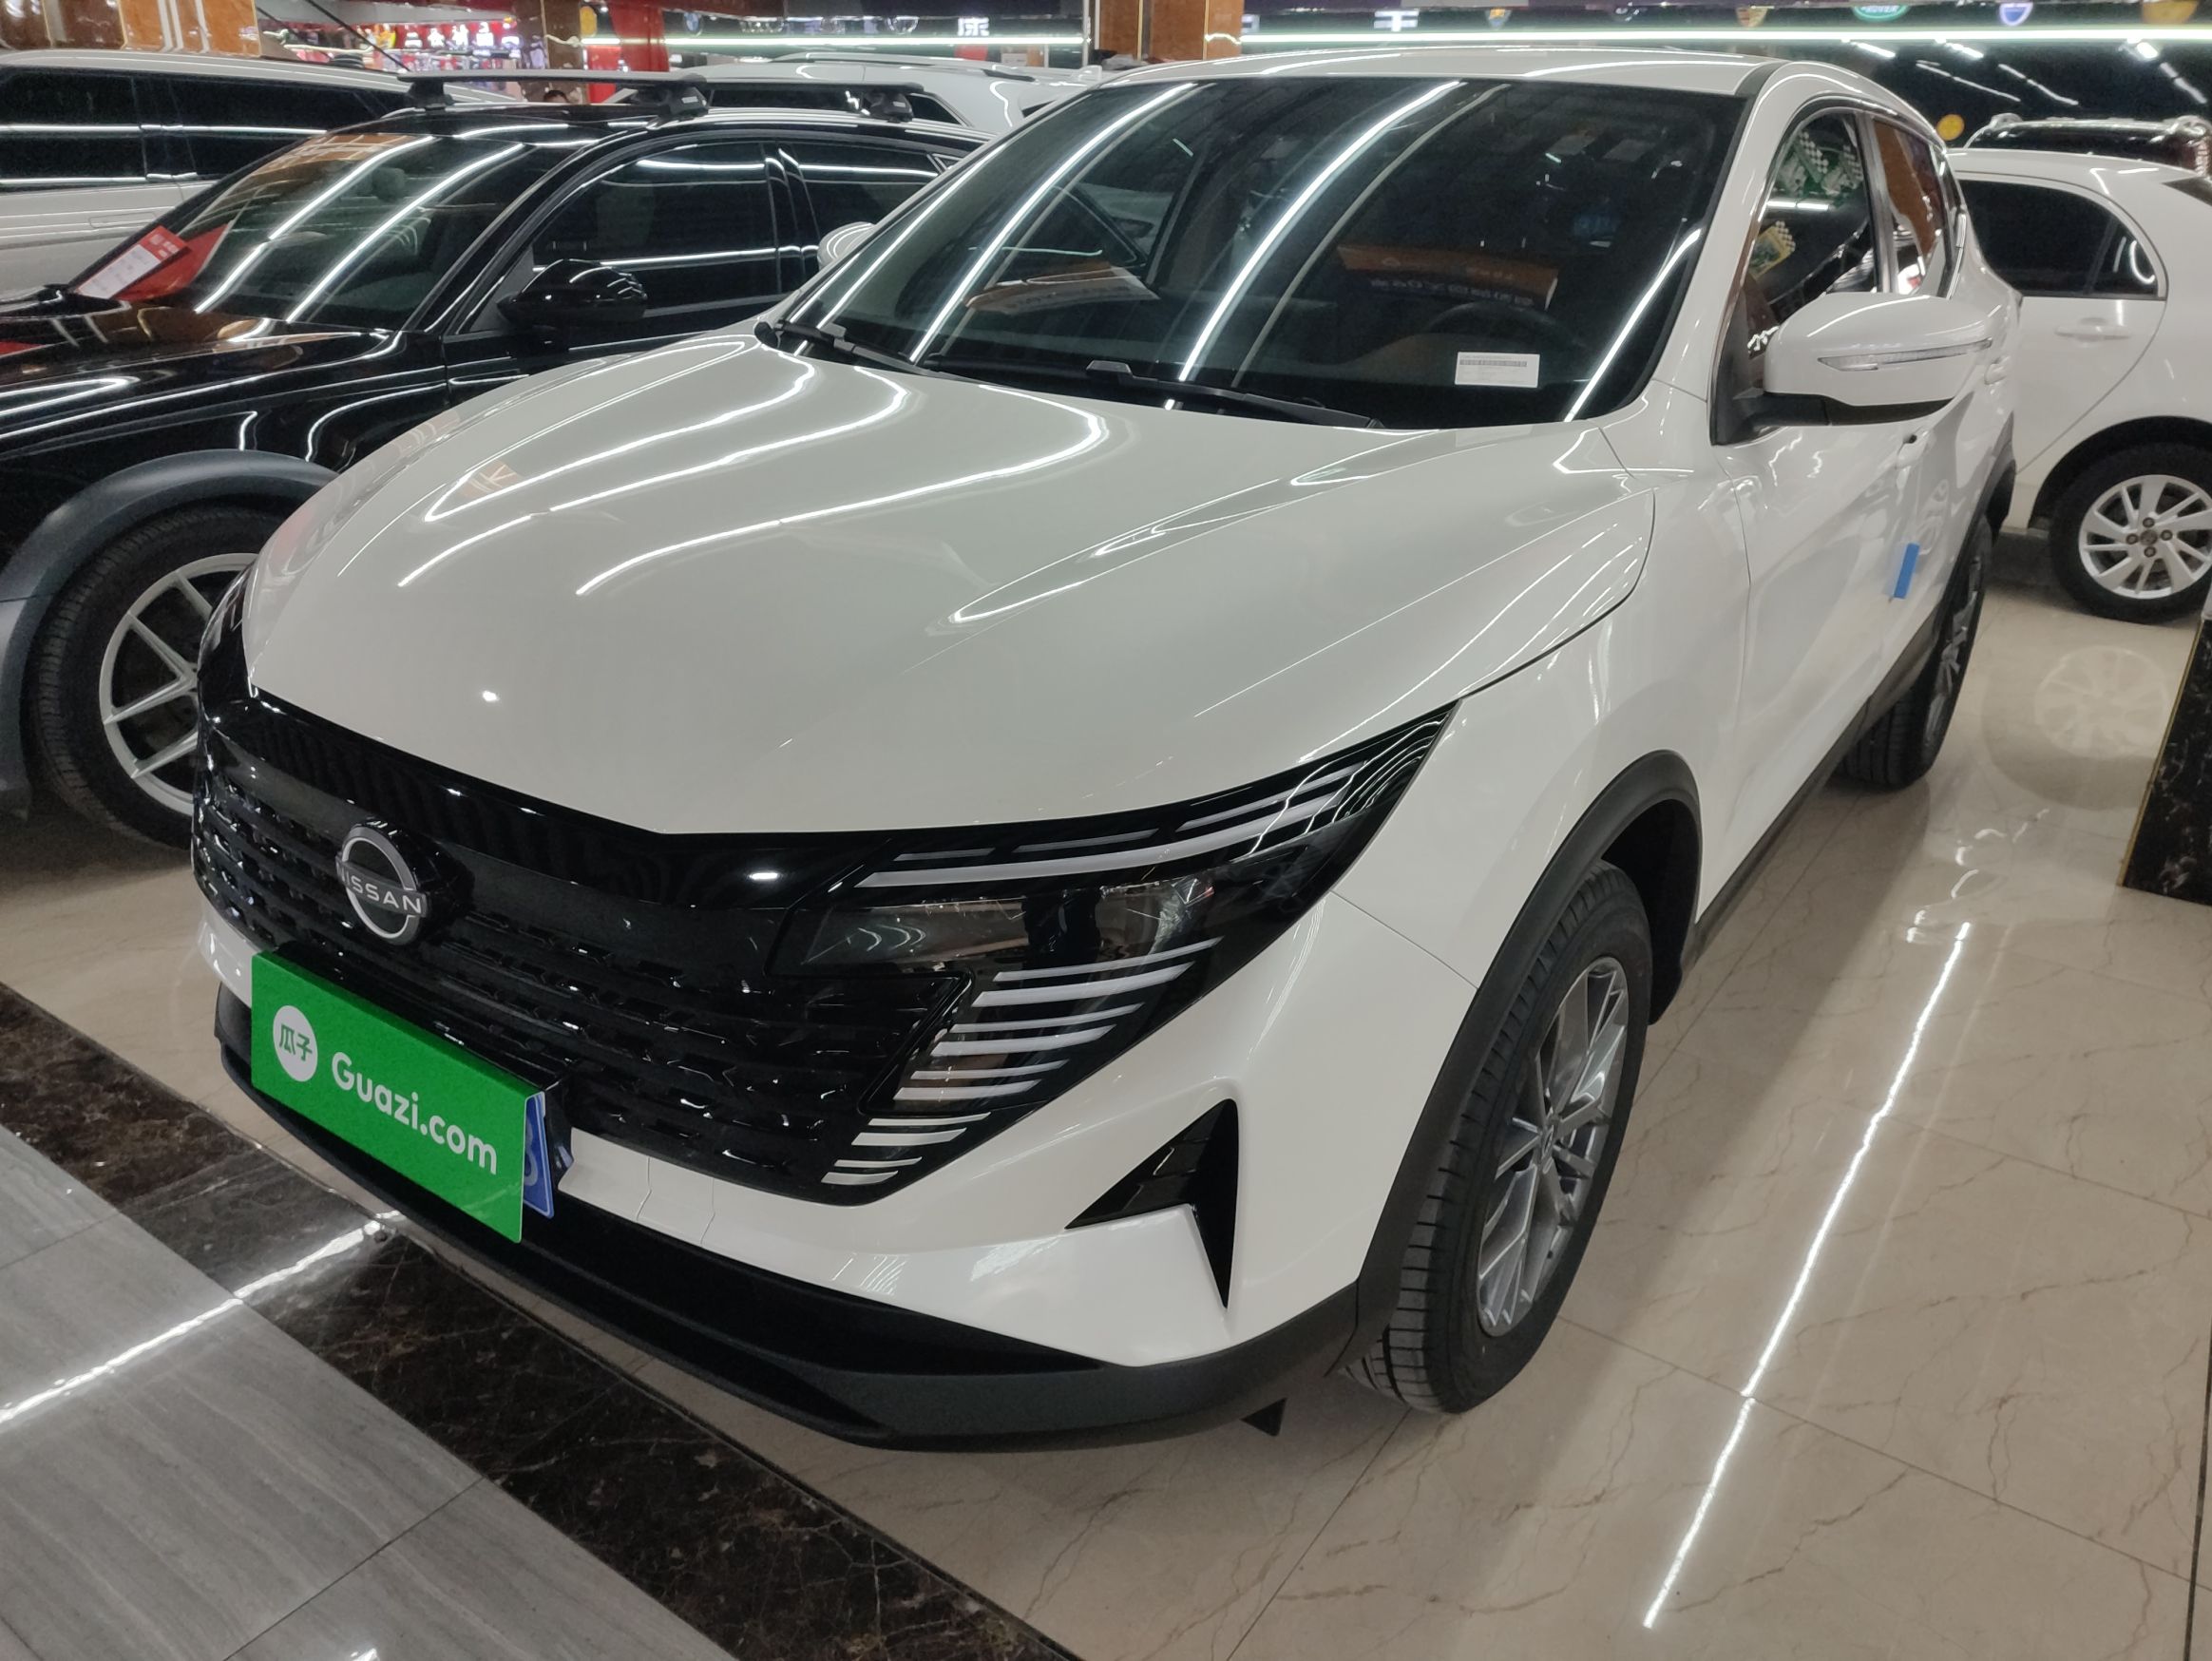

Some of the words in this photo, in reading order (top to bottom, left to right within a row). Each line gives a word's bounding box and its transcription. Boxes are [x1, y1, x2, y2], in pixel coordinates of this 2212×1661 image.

[336, 862, 422, 914] NISSAN
[279, 1023, 313, 1061] 瓜子
[332, 1051, 498, 1175] Guazi.com
